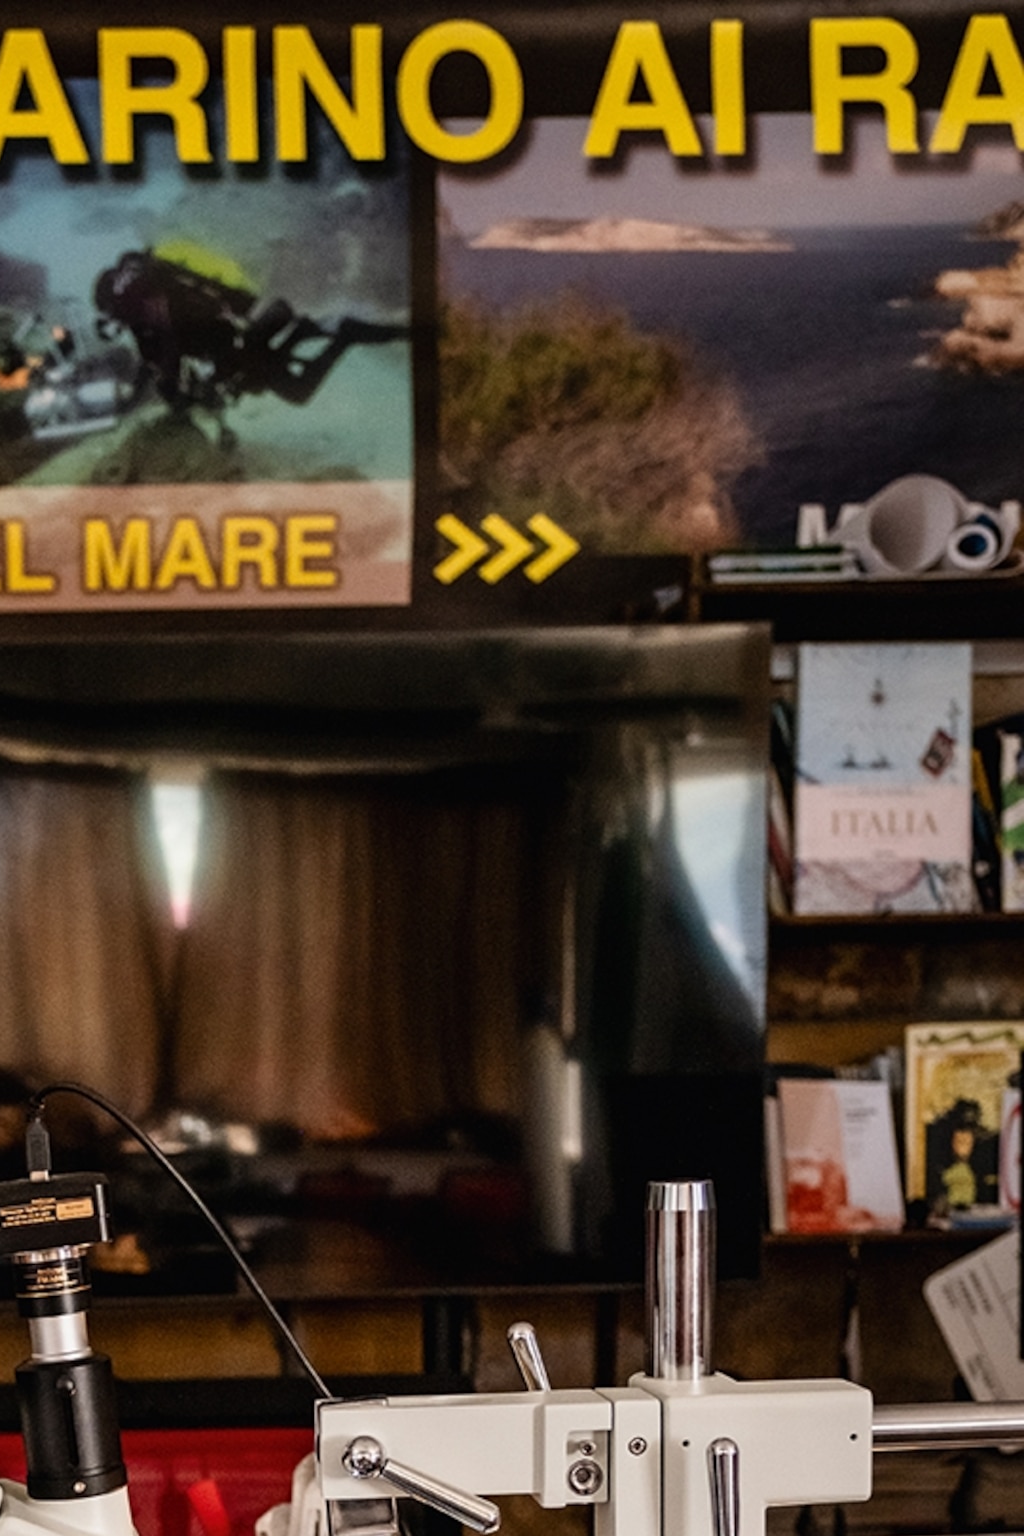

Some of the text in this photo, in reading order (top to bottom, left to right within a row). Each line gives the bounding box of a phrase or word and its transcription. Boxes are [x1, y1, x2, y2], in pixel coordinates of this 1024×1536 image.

[582, 19, 746, 158] AI
[808, 13, 1024, 156] RA
[83, 514, 338, 590] MARE
[831, 809, 939, 837] ITALIA
